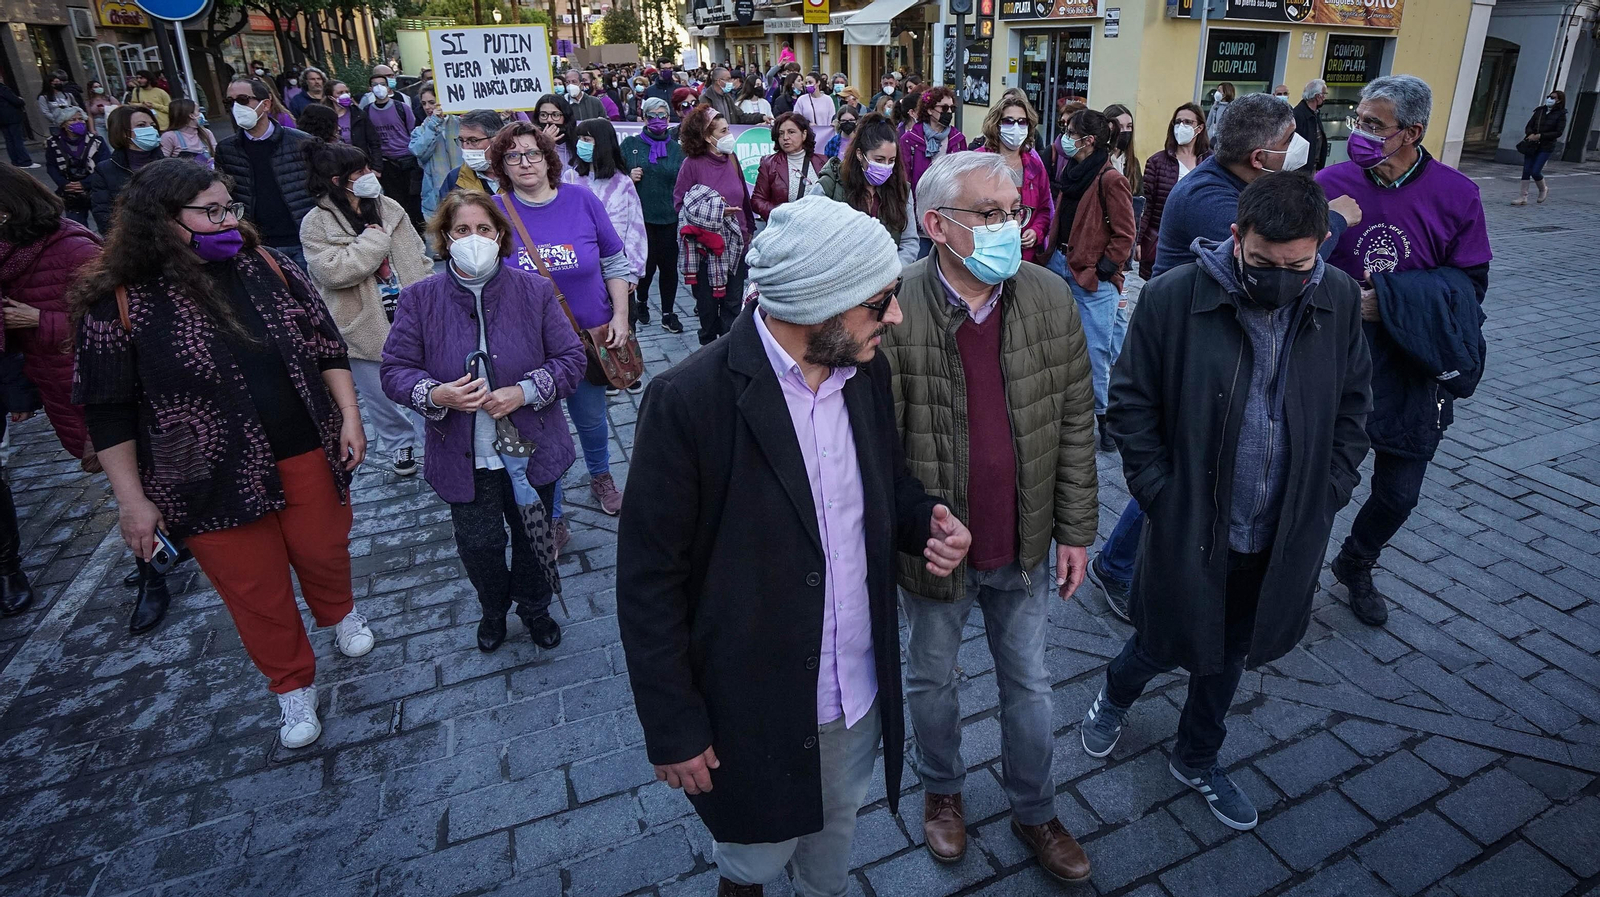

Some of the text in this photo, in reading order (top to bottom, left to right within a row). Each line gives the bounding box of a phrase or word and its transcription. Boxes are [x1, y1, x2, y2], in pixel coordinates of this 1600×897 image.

[1003, 1, 1031, 14] ORO/PLATA
[440, 32, 468, 55] SI
[483, 33, 532, 54] PUTIN
[1218, 41, 1255, 56] COMPRO
[1065, 51, 1090, 62] ORO/PLAT
[1333, 44, 1365, 57] COMPRO
[444, 56, 530, 78] FUERA MUJER
[1212, 59, 1257, 74] ORO/PLATA
[1327, 59, 1366, 72] ORO/PLATA
[1326, 73, 1363, 82] eurosxoro.es
[446, 77, 542, 103] NO HABRÍA GUERRA
[1026, 82, 1041, 91] COMPRO
[1362, 222, 1387, 237] unimos,
[1356, 236, 1364, 248] nos
[1353, 248, 1360, 256] Si
